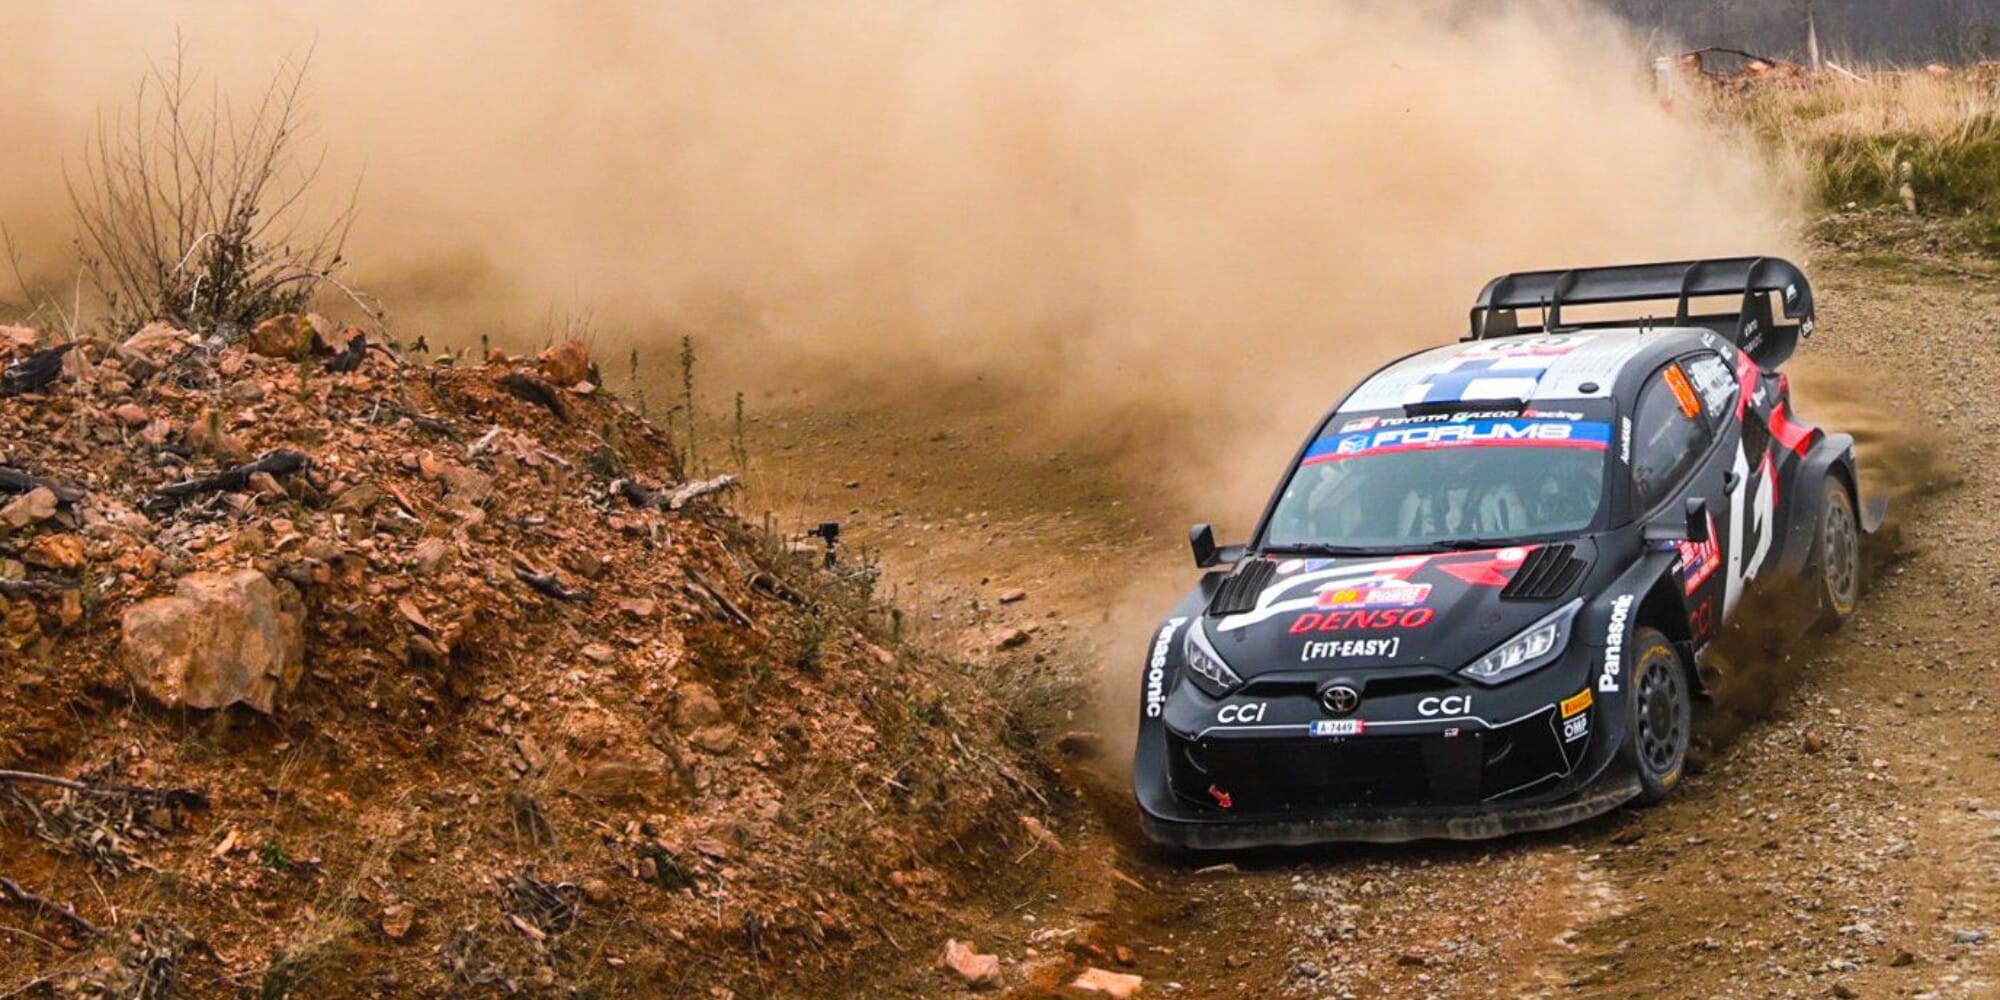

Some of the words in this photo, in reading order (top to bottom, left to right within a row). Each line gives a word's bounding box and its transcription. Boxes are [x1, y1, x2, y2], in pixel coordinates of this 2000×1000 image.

[1380, 413, 1449, 427] TOYOTA
[1450, 410, 1519, 422] GAZOO
[1521, 408, 1584, 421] Racing
[1371, 422, 1573, 448] FORUM8
[1288, 607, 1437, 635] DENSO
[1598, 593, 1635, 693] Panasonic
[1146, 616, 1189, 718] Panasonic
[1564, 717, 1588, 738] OMP
